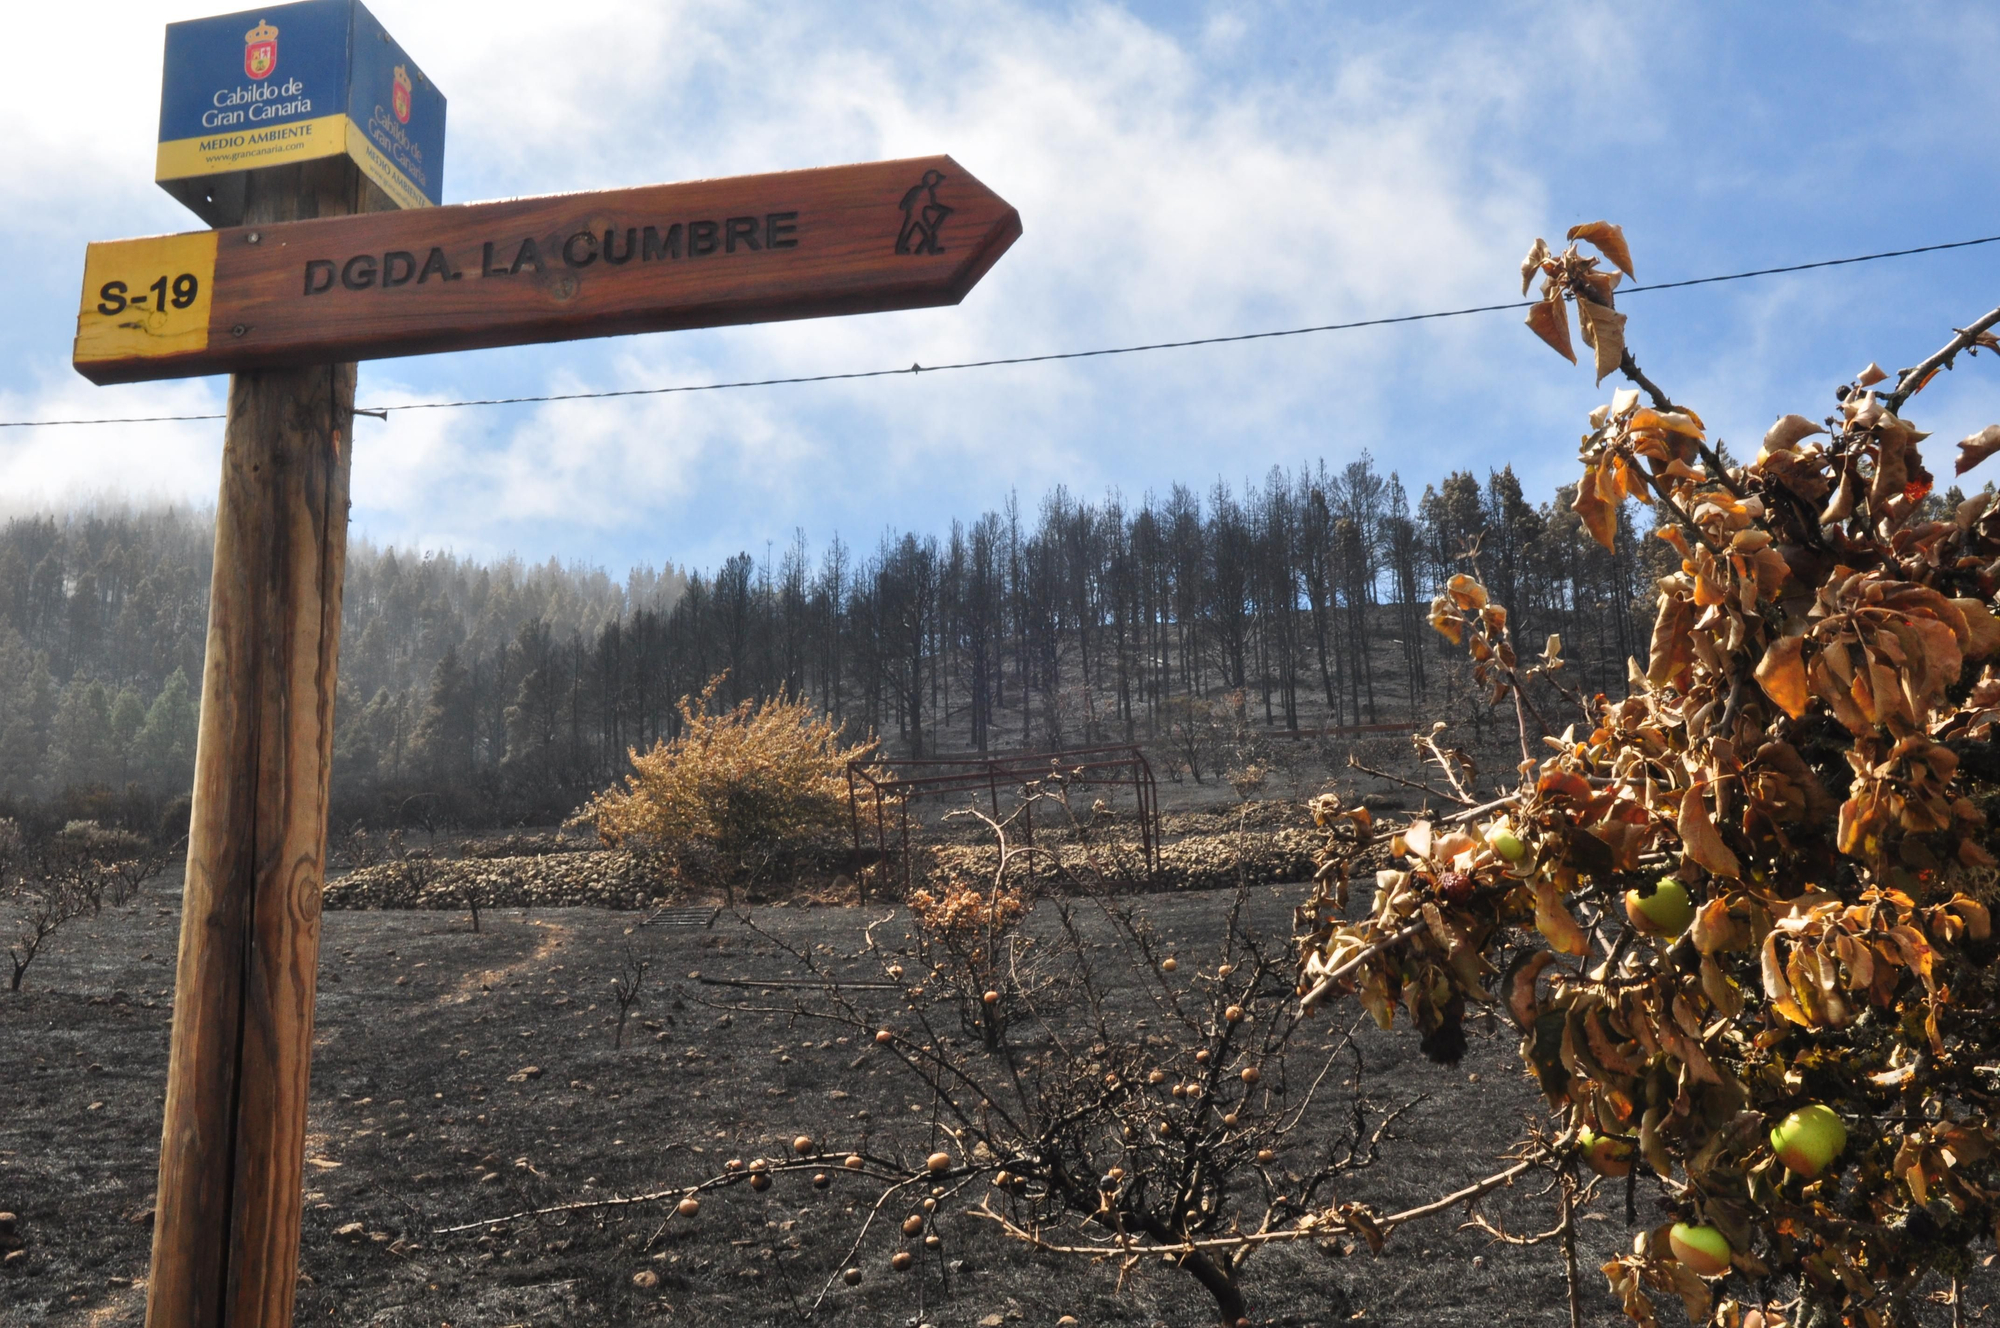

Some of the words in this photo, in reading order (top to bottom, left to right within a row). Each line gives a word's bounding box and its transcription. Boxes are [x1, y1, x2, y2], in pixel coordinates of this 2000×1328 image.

[213, 81, 278, 107] Cabildo
[281, 77, 303, 97] de
[202, 110, 244, 128] Gran
[248, 96, 311, 121] Canaria
[199, 136, 245, 152] MEDIO
[248, 124, 312, 145] AMBIENTE
[375, 104, 410, 150] Cabildo
[411, 142, 422, 164] de
[206, 142, 305, 163] www.grancanaria.com
[366, 146, 391, 175] MEDIO
[368, 118, 391, 152] Gran
[393, 143, 426, 187] Canaria
[303, 247, 462, 296] DGDA.
[481, 237, 545, 278] LA
[562, 211, 799, 269] CUMBRE
[97, 272, 199, 316] S-19
